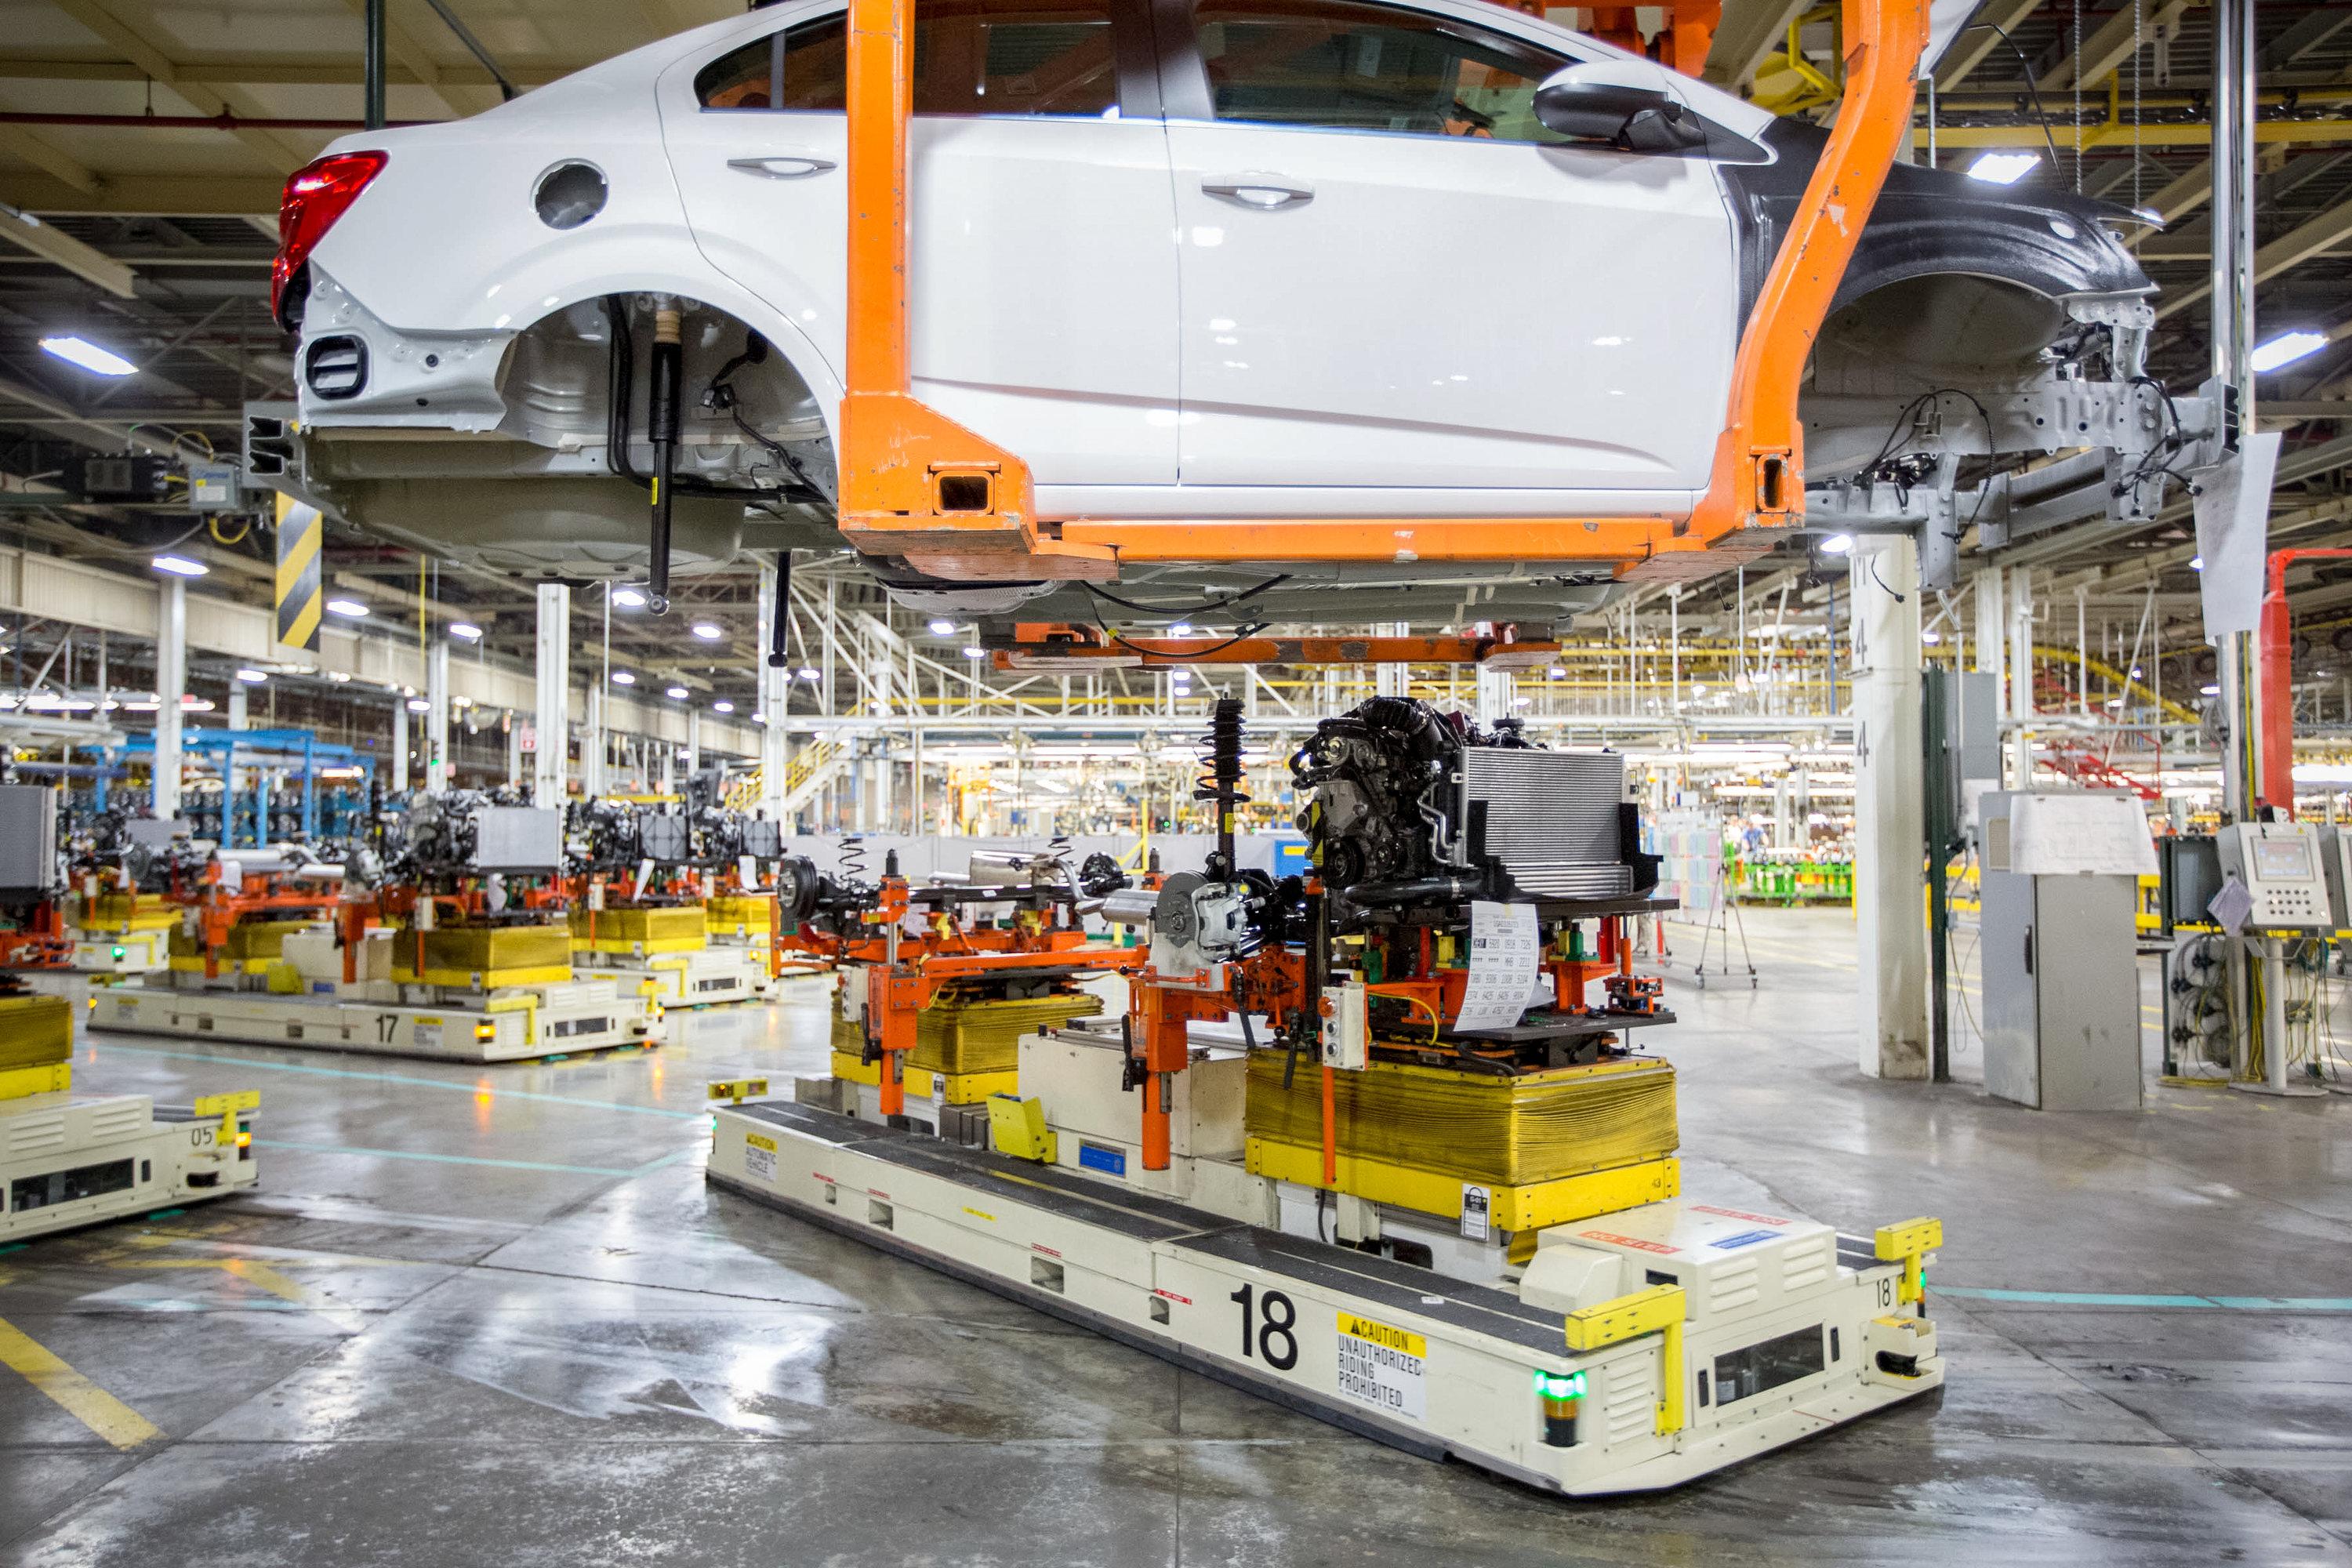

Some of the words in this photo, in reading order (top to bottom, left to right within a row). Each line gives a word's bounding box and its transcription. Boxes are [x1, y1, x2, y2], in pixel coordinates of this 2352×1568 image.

[1855, 618, 1867, 664] 4
[1857, 720, 1869, 768] 4
[376, 1014, 399, 1043] 17
[191, 1127, 212, 1146] 05
[1877, 1278, 1891, 1308] 18
[1230, 1283, 1298, 1370] 18
[1361, 1320, 1409, 1350] CAUTION
[1338, 1334, 1421, 1376] UNAUTHORIZED
[1338, 1353, 1374, 1379] RIDING
[1338, 1371, 1403, 1406] PROHIBITED
